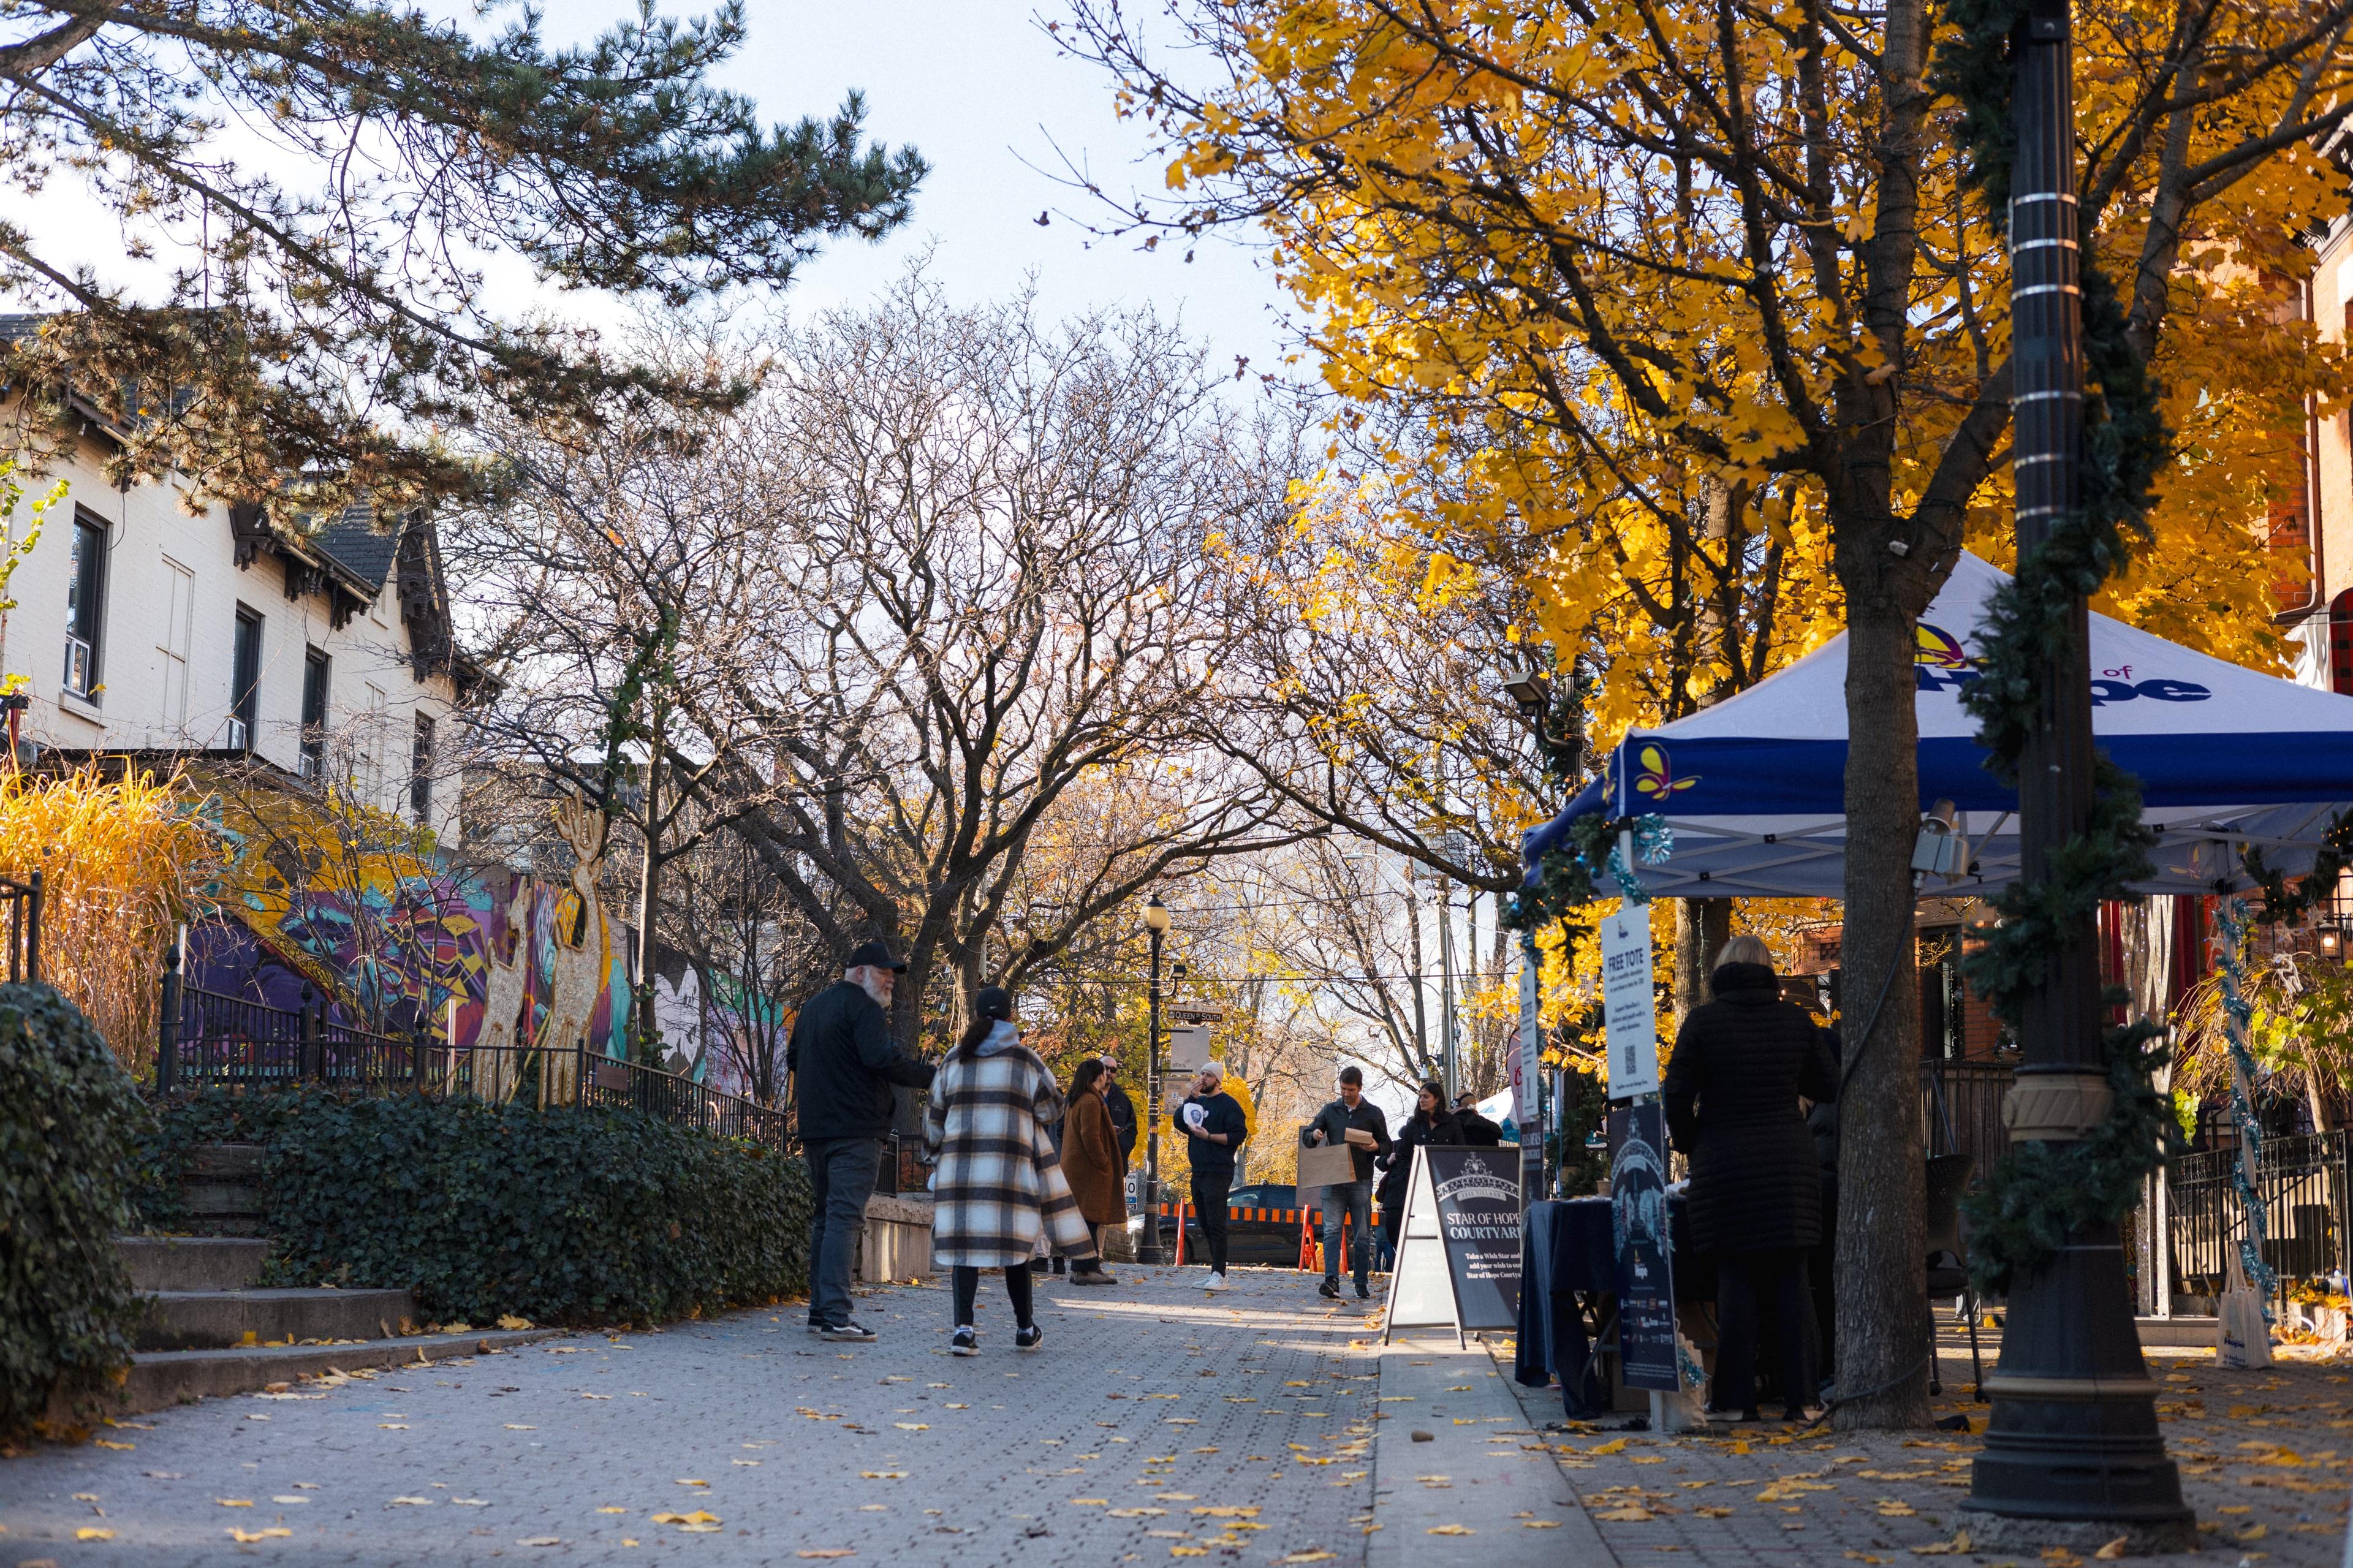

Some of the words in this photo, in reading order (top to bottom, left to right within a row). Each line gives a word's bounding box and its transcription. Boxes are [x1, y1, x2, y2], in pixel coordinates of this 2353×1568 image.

[2102, 665, 2133, 680] of
[1608, 953, 1624, 973] FREE
[1624, 947, 1644, 968] TOTE
[1175, 1011, 1195, 1020] QUEEN
[1202, 1013, 1221, 1021] SOUTH
[1447, 1213, 1476, 1225] STAR
[1477, 1213, 1491, 1225] OF
[1494, 1213, 1520, 1225] HOPE
[1450, 1227, 1520, 1239] COURTYAR
[1634, 1263, 1648, 1280] Hope
[2224, 1338, 2245, 1348] Hope
